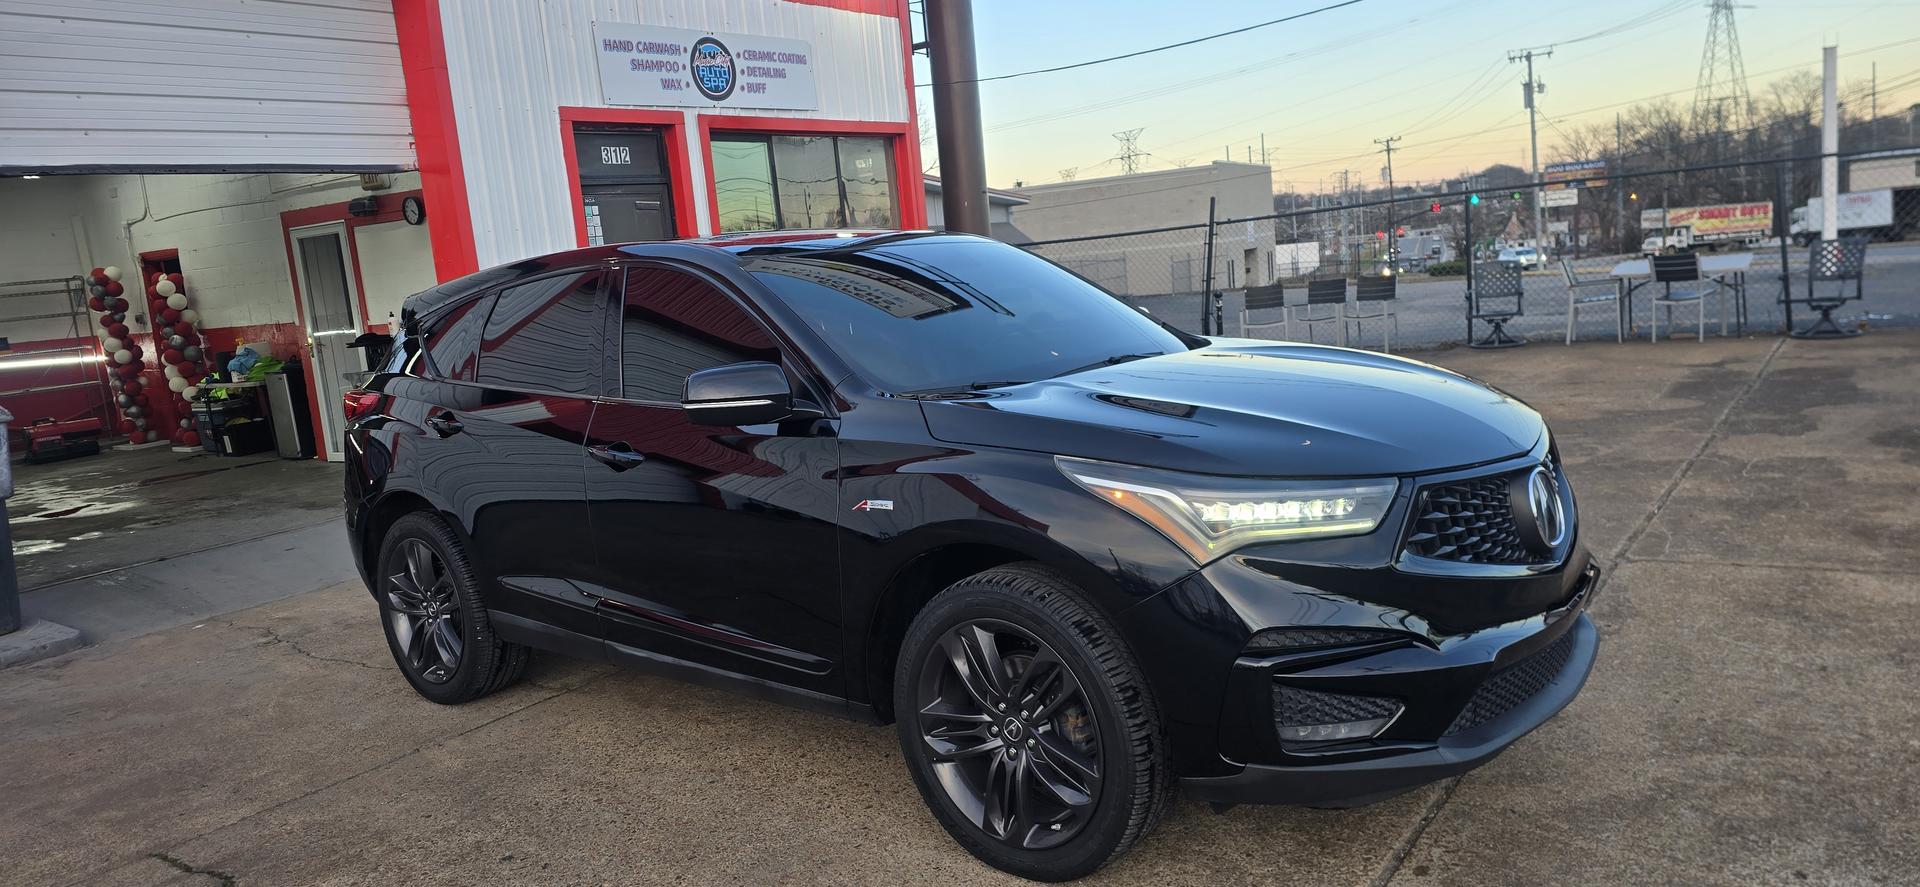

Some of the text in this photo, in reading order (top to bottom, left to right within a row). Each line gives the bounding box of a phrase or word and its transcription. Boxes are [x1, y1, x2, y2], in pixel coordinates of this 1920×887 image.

[603, 39, 681, 56] HAND CARWASH
[743, 49, 807, 65] CERAMIC COATING
[630, 58, 680, 73] SHAMPOO
[700, 66, 729, 79] AUTO
[746, 66, 787, 79] DETAILING
[660, 78, 683, 91] WAX
[703, 77, 727, 90] SPA
[746, 82, 766, 94] BUFF
[601, 146, 630, 164] 312
